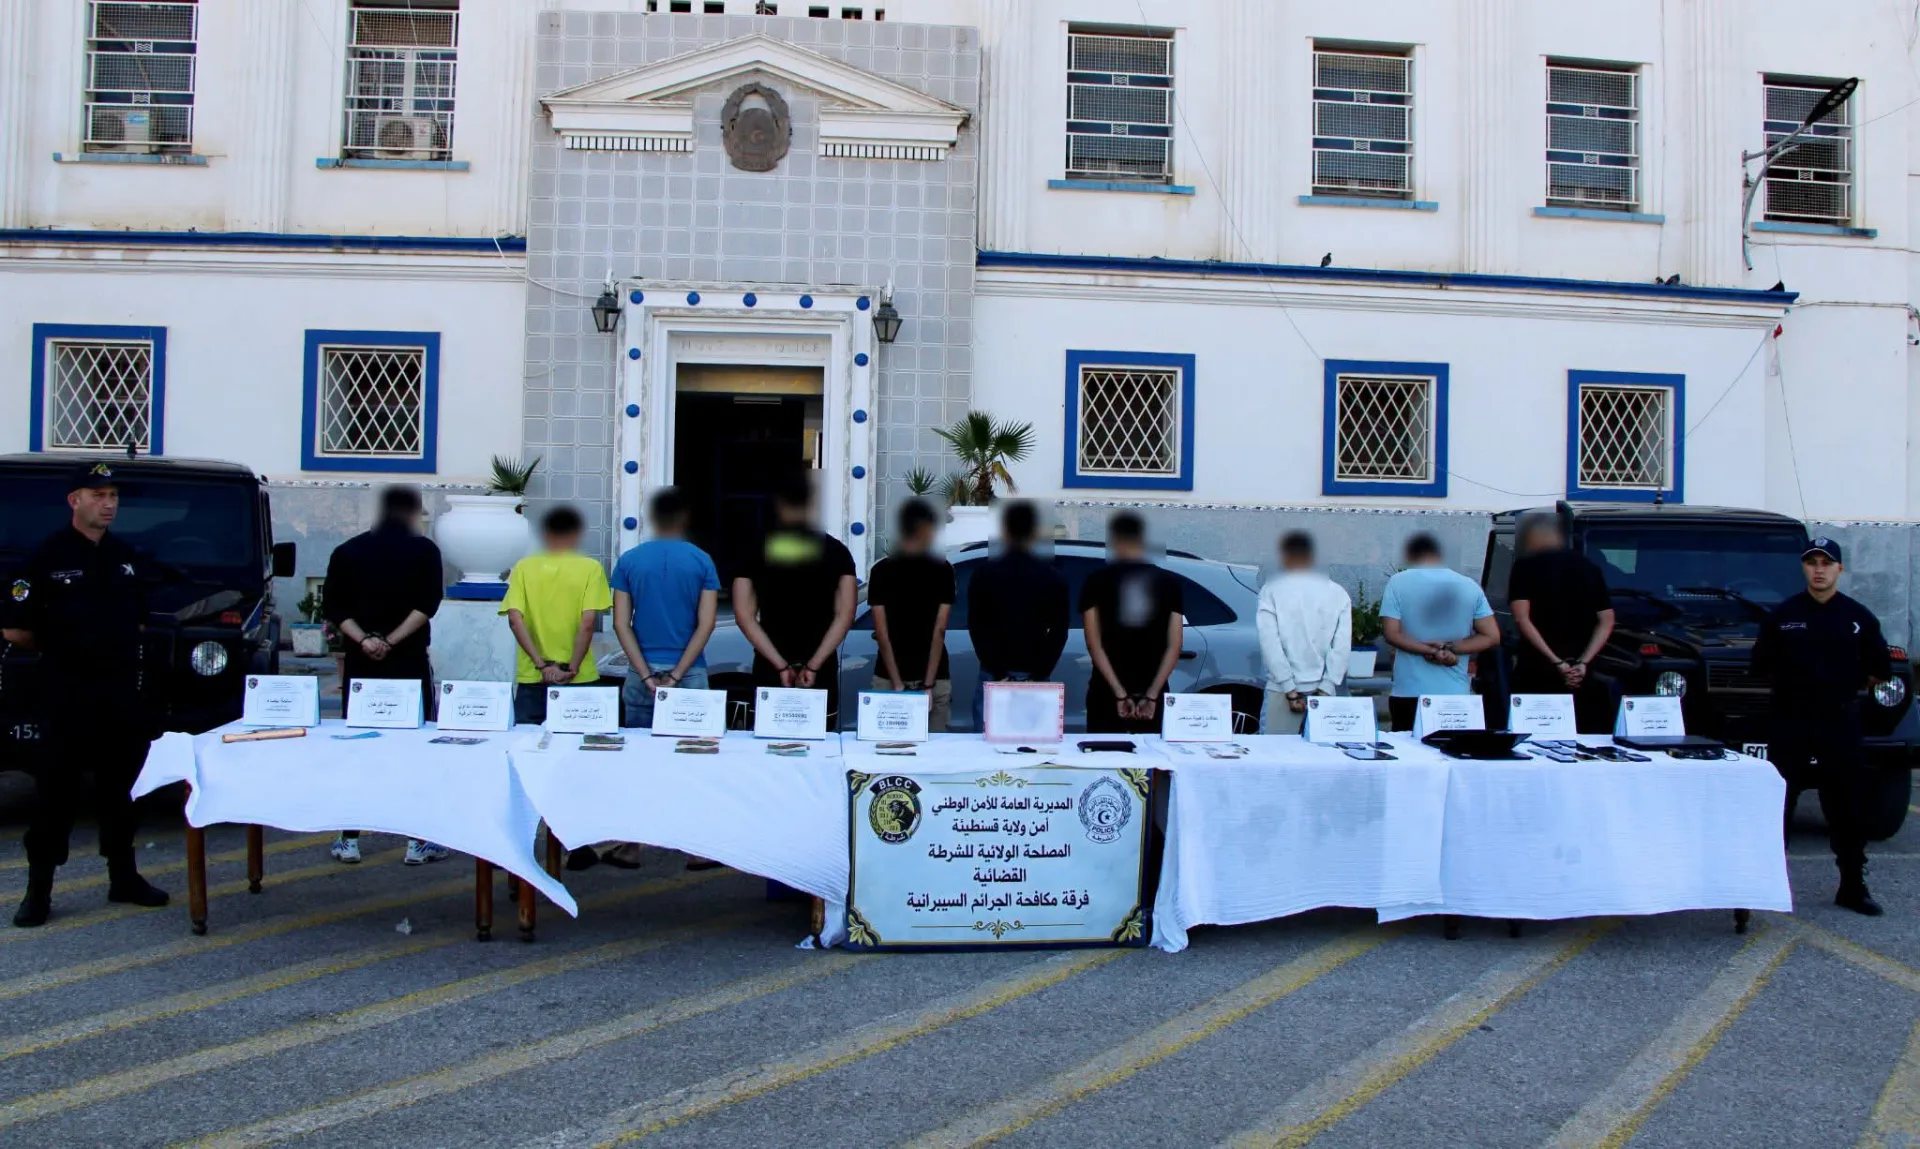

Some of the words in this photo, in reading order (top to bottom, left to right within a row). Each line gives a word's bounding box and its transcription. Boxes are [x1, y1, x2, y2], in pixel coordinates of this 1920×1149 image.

[878, 777, 912, 790] BLCC
[931, 797, 969, 816] الوطني
[971, 796, 998, 813] للأمن
[1001, 797, 1031, 810] العامة
[1033, 797, 1073, 814] المديرية
[1002, 818, 1027, 837] ولاية
[1029, 817, 1049, 837] أمن
[928, 844, 974, 863] للشرطة
[977, 844, 1019, 863] الولائية
[1023, 844, 1071, 859] المصلحة
[973, 867, 1027, 885] القضائية
[906, 892, 968, 913] السيبرانية
[970, 893, 1012, 914] الجرائم
[1015, 891, 1058, 907] مكافحة
[1061, 890, 1090, 910] فرقة
